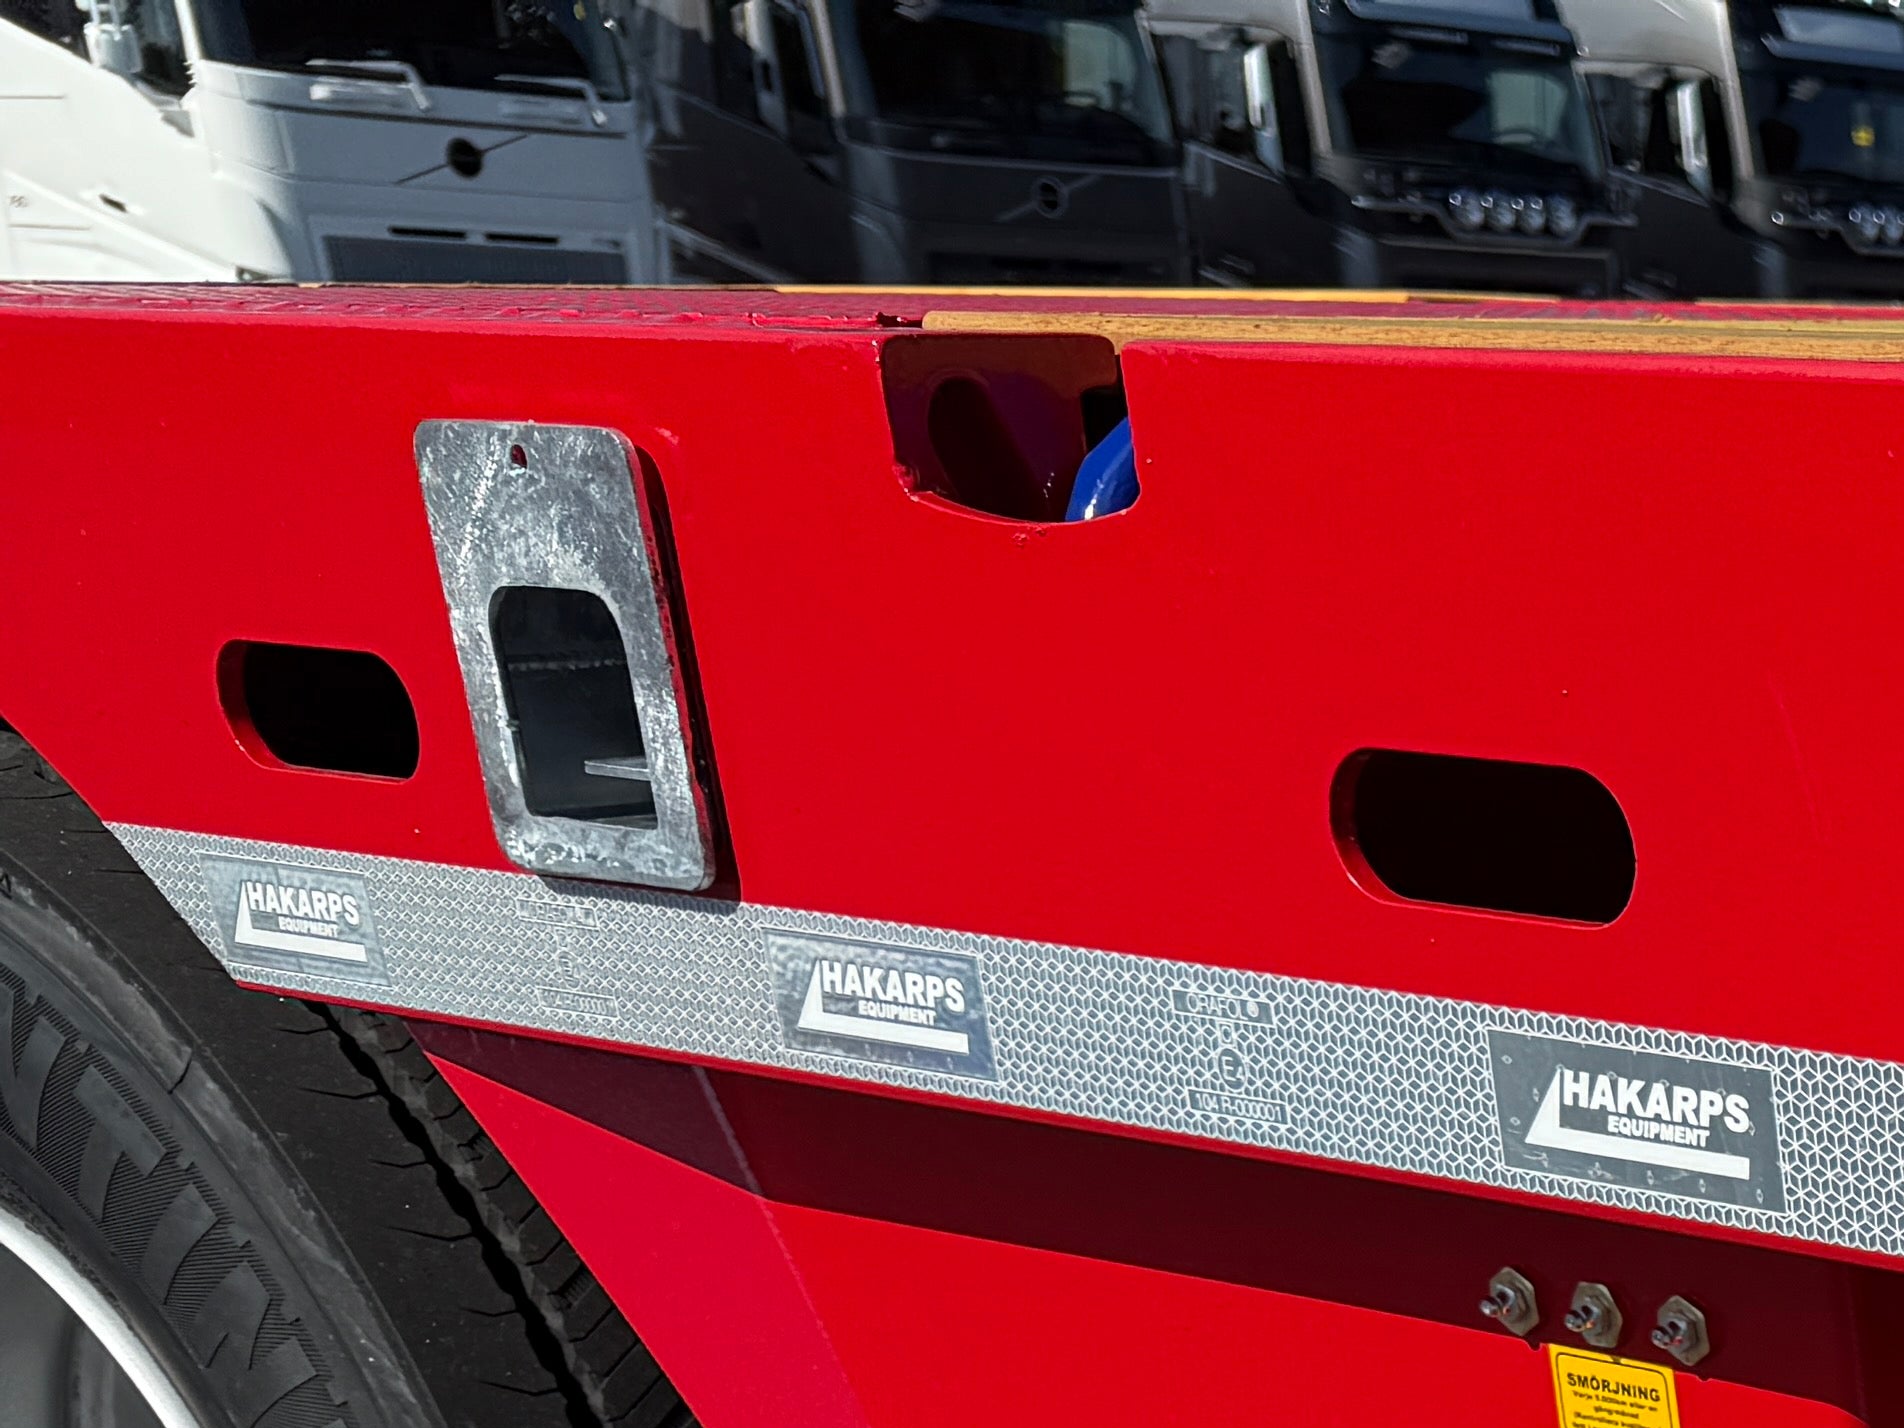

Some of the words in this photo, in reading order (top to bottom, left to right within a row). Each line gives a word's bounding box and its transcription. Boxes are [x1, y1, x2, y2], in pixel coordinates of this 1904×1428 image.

[246, 881, 360, 926] HAKARPS
[821, 959, 965, 1013] HAKARPS
[858, 1000, 937, 1026] EQUIPMENT
[1563, 1069, 1750, 1133] HAKARPS
[1607, 1114, 1710, 1147] EQUIPMENT
